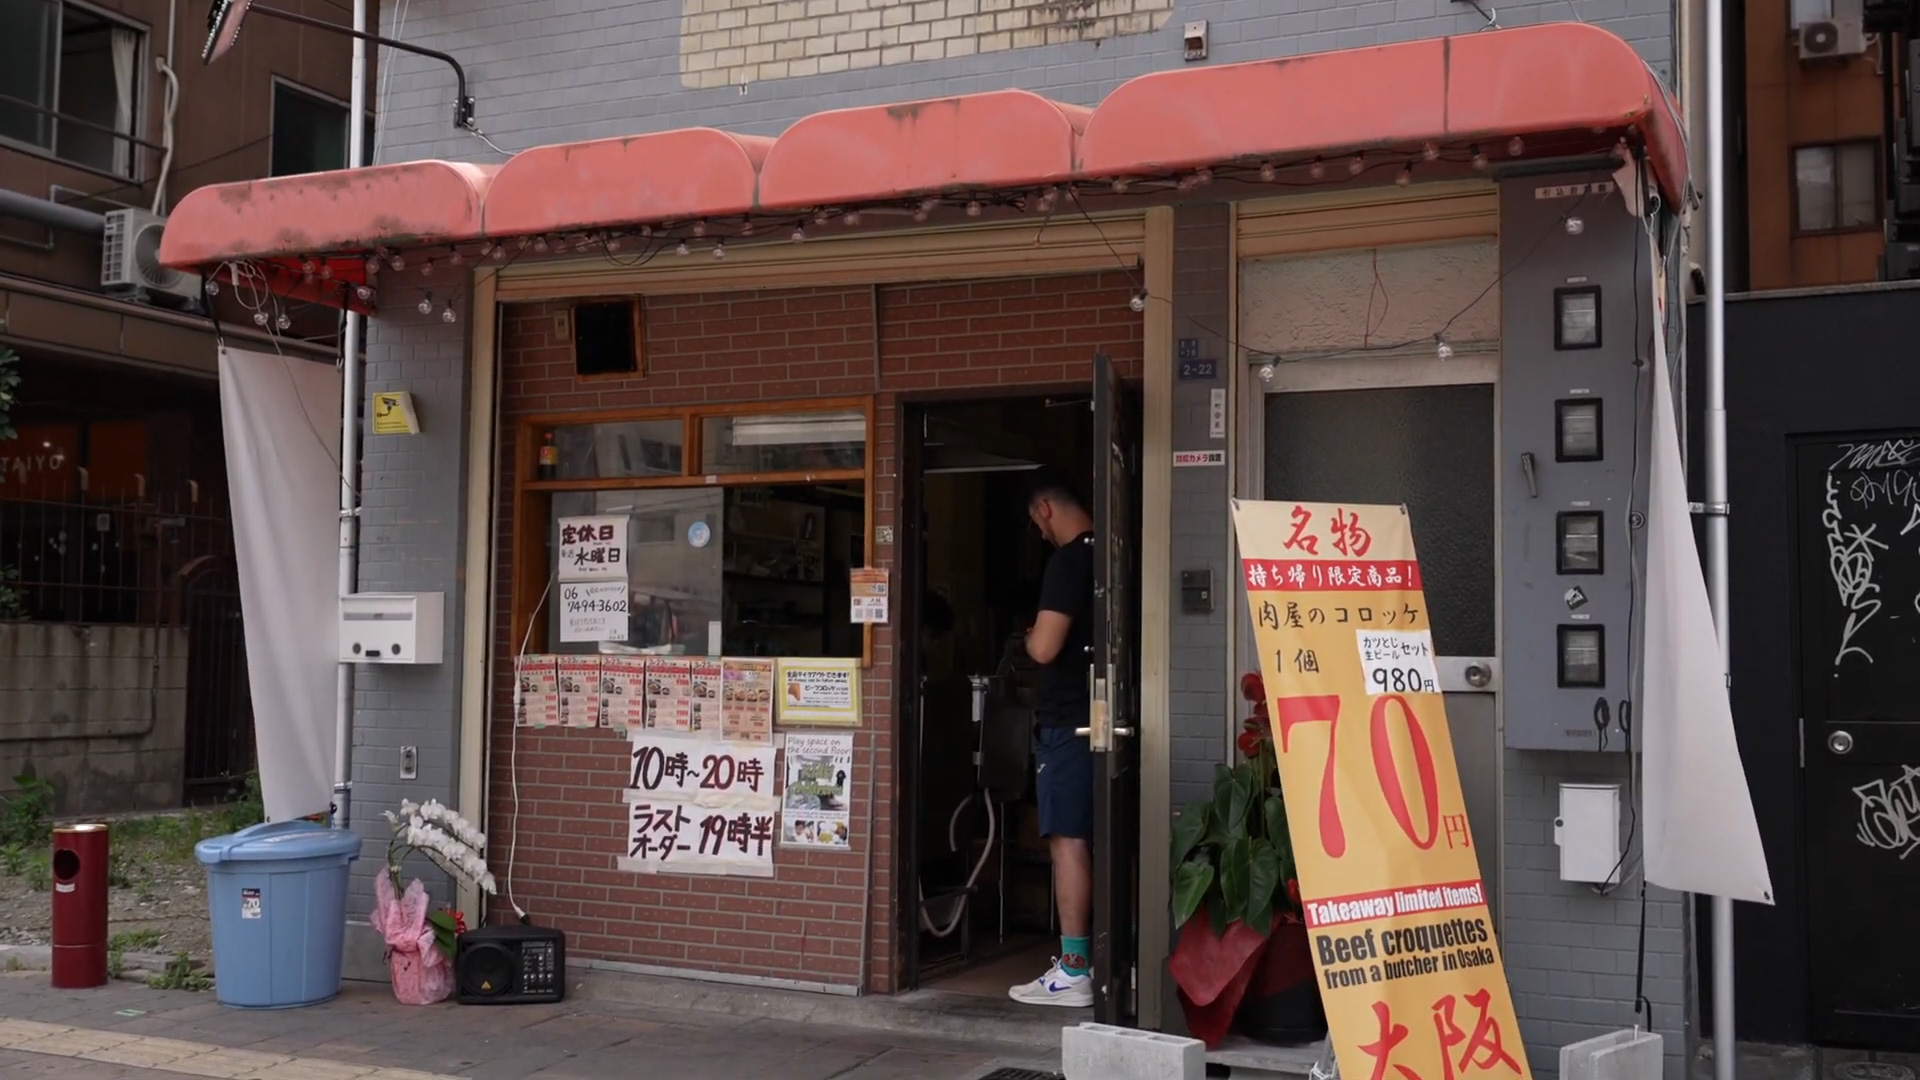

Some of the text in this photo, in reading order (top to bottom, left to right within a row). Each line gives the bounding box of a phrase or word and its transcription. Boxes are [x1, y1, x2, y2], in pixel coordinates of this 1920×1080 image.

[1183, 364, 1212, 375] 2-22
[562, 524, 613, 546] 定休日
[1283, 505, 1371, 557] 名物
[574, 547, 620, 565] 水曜日
[564, 587, 578, 600] 06
[567, 599, 627, 613] 7494-3602
[1258, 601, 1419, 629] 肉屋のコロッケ
[1363, 636, 1429, 657] カツとじ セット
[1365, 650, 1400, 661] 生ビール
[802, 746, 829, 754] second
[807, 739, 828, 748] space
[634, 804, 691, 833] ラスト
[698, 812, 773, 856] 19時半
[630, 833, 691, 861] オーダー
[1307, 882, 1483, 925] Takeaway limited items!
[1316, 918, 1488, 965] Beef croquettes
[1324, 947, 1495, 989] from a butcher in Osaka
[1357, 988, 1522, 1080] 大阪
